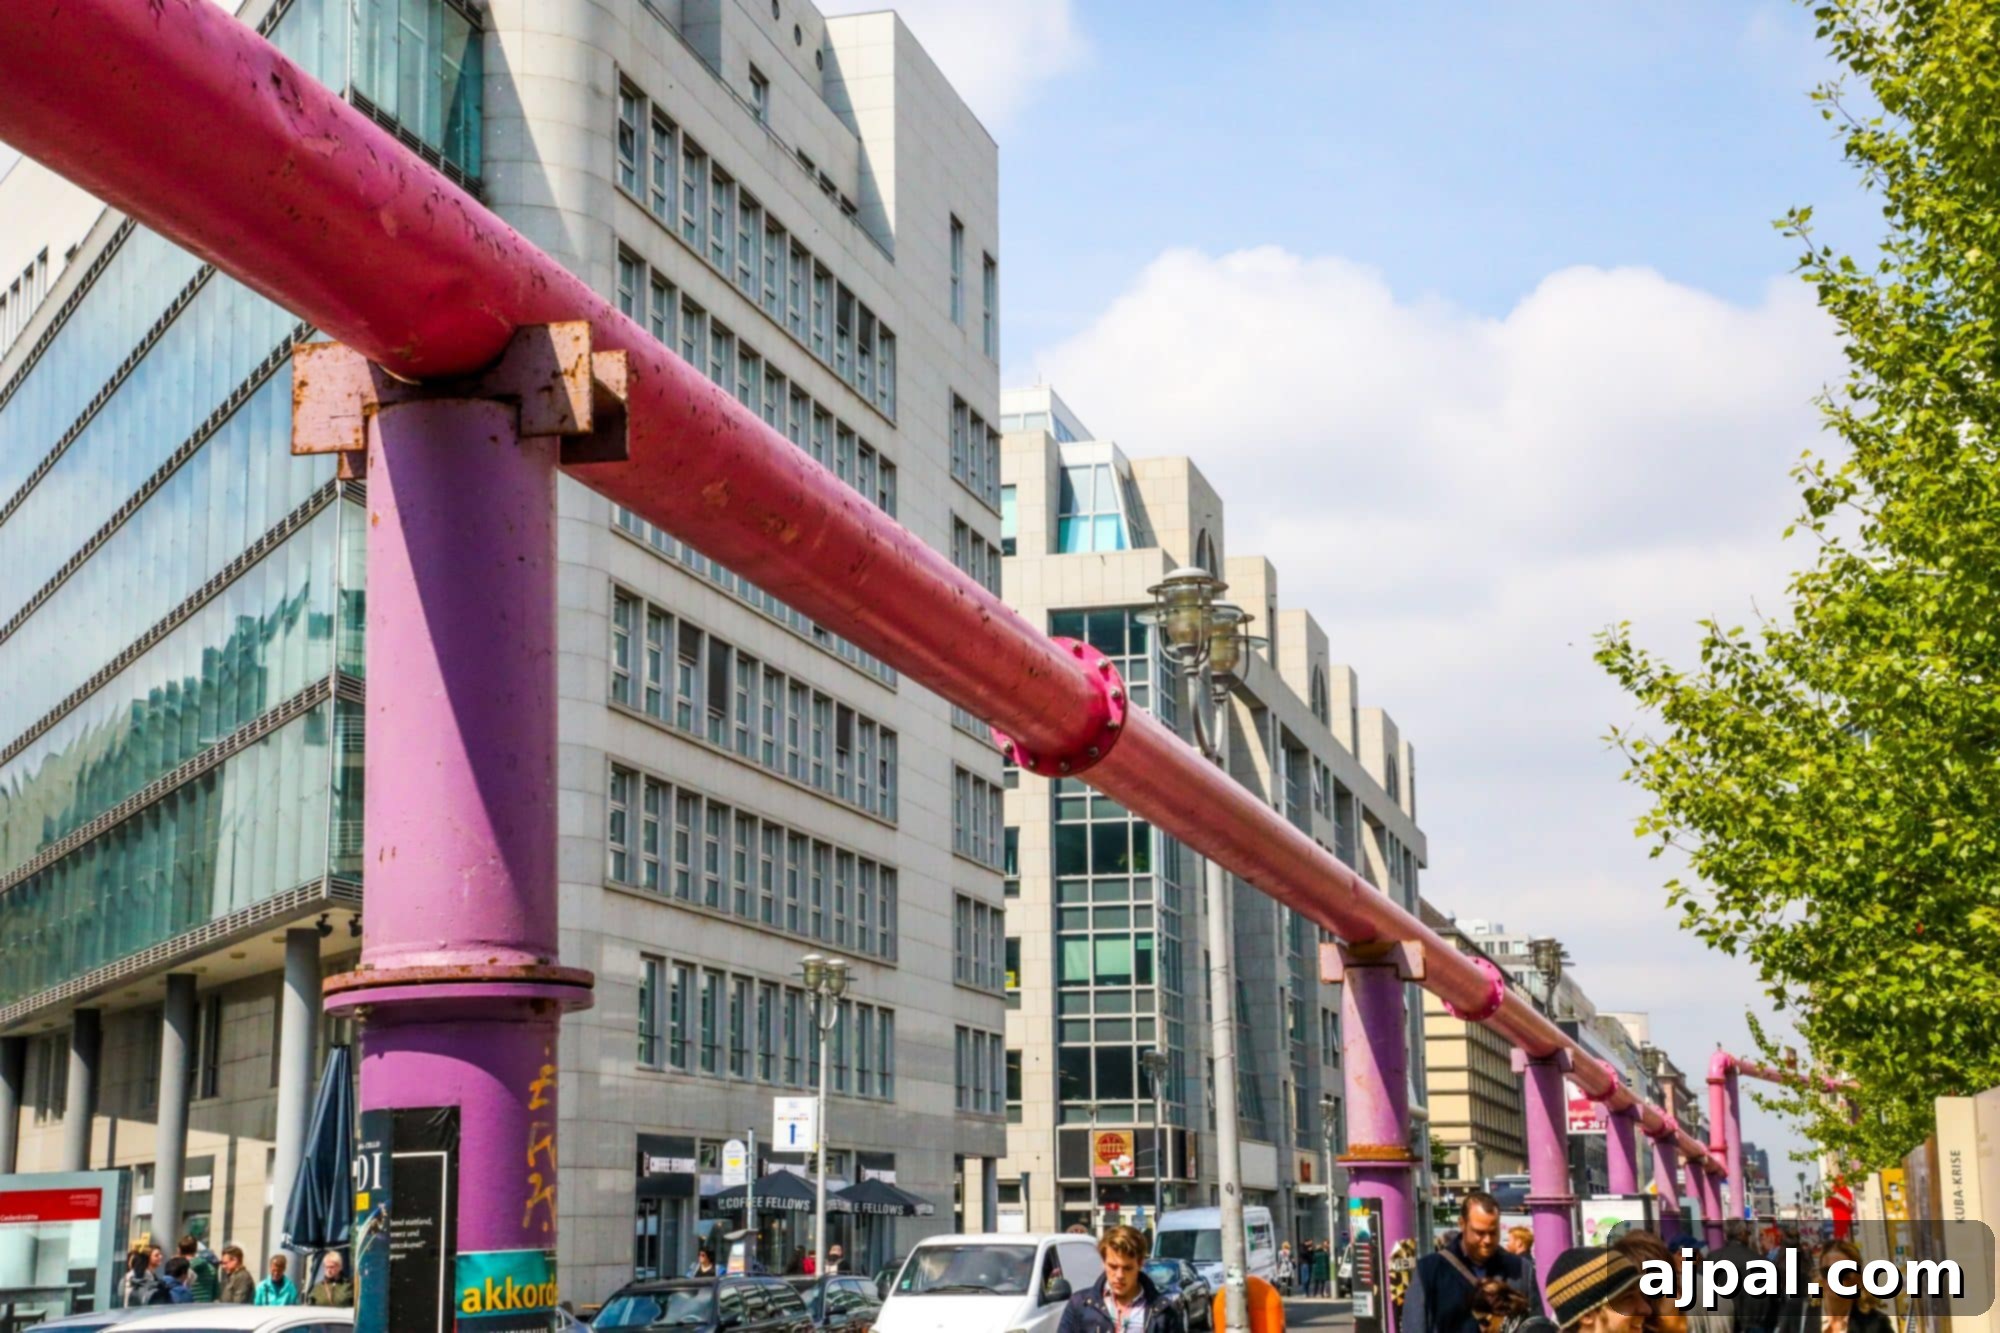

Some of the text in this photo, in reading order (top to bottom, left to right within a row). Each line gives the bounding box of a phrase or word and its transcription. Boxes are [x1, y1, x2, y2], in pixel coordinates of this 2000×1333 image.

[1950, 1150, 1966, 1225] KUBA-KRISE
[765, 1196, 811, 1212] FELLOWS
[862, 1203, 904, 1216] FELLOWS
